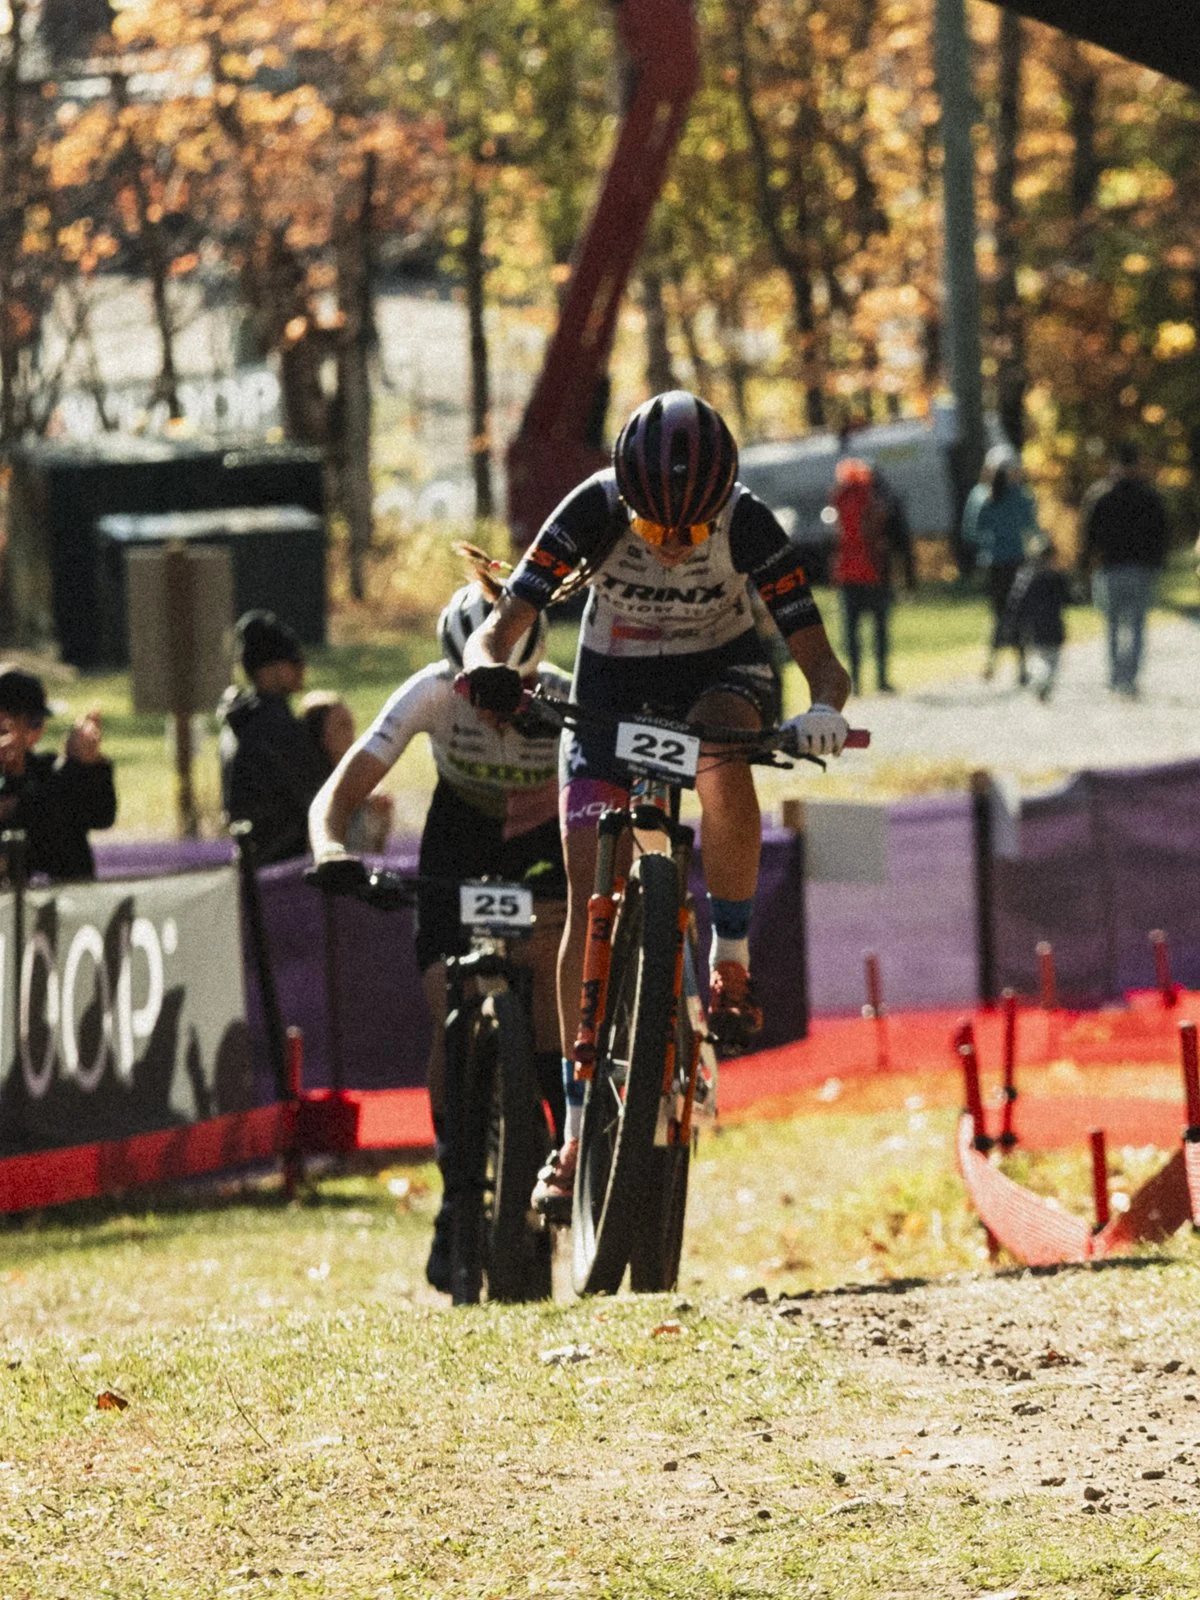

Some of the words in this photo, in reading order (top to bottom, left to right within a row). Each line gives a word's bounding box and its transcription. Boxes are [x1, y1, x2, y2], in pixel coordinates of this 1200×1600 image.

[603, 572, 727, 605] TRINX
[631, 733, 686, 766] 22
[474, 893, 520, 917] 25
[0, 917, 165, 1100] OOP
